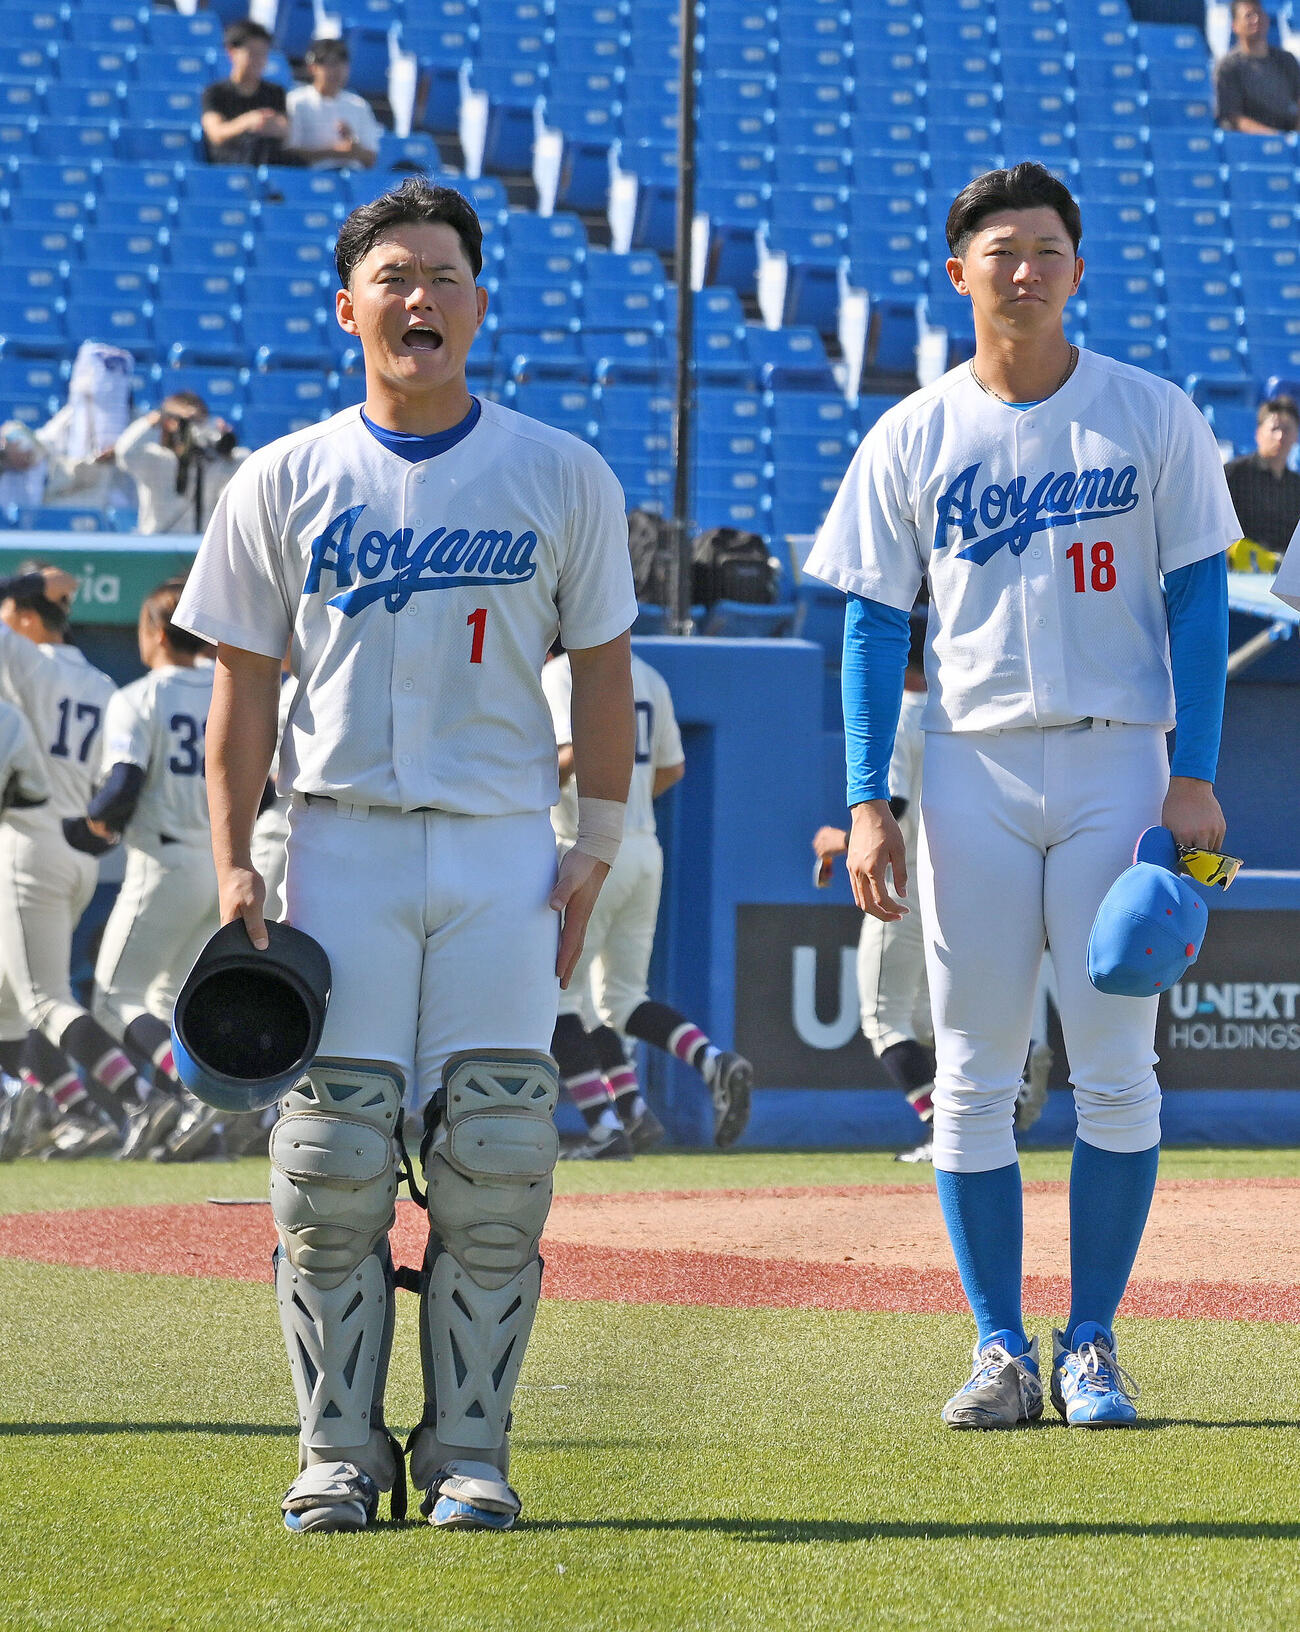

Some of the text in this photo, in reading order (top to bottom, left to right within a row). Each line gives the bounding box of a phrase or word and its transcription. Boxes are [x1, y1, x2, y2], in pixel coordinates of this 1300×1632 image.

[933, 462, 1139, 566] Aoyama
[303, 504, 537, 618] Aoyama
[1066, 541, 1117, 593] 18
[467, 608, 488, 664] 1
[50, 698, 101, 763] 17
[170, 714, 206, 778] 3
[1171, 983, 1300, 1019] U-NEXT
[1169, 1023, 1300, 1050] HOLDINGS
